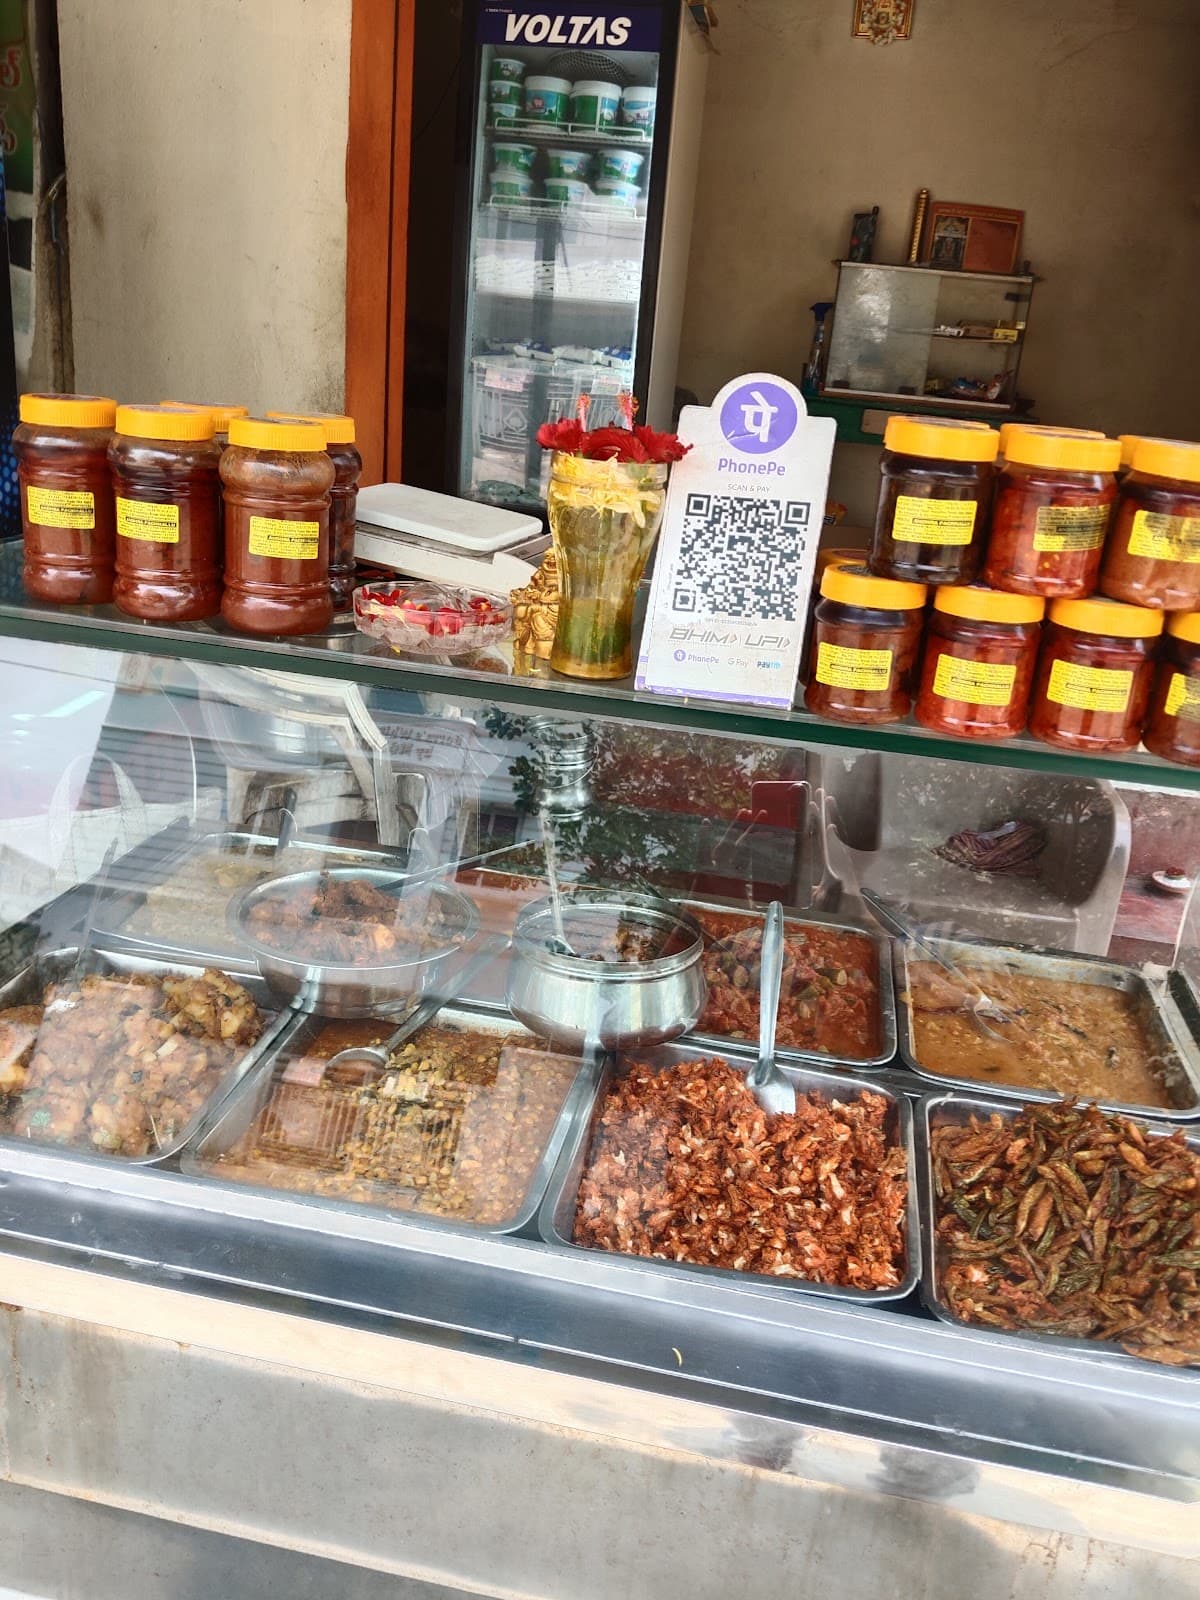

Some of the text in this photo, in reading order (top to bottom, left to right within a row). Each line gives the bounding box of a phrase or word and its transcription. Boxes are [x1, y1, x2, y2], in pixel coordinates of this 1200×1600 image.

[505, 13, 632, 46] VOLTAS
[718, 458, 786, 476] PhonePe
[727, 483, 748, 492] SCAN
[756, 485, 770, 493] PAY
[669, 627, 730, 644] BHIM
[744, 633, 785, 648] UPI
[687, 654, 720, 664] PhonePe
